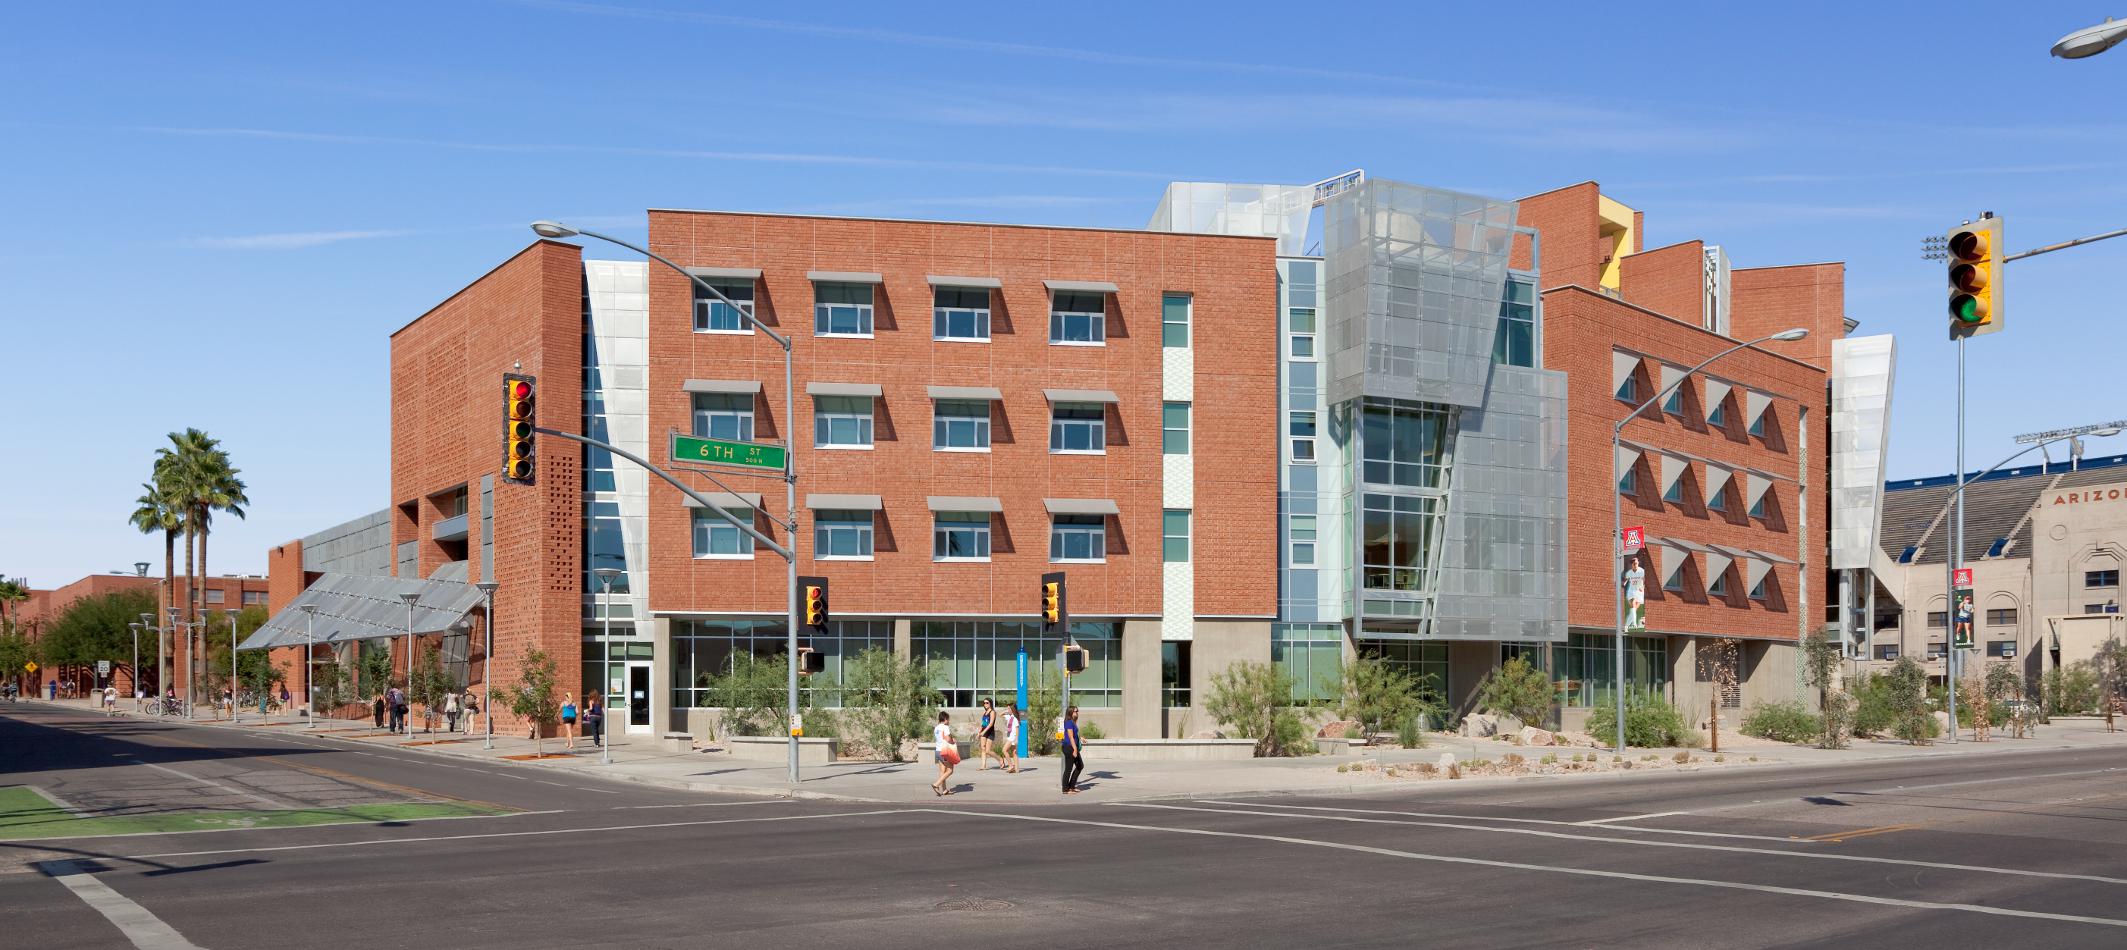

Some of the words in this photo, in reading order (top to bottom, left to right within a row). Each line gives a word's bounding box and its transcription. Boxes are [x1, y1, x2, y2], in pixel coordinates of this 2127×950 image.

[700, 445, 733, 459] 6TH
[750, 448, 761, 456] ST
[2053, 487, 2127, 505] ARIZO
